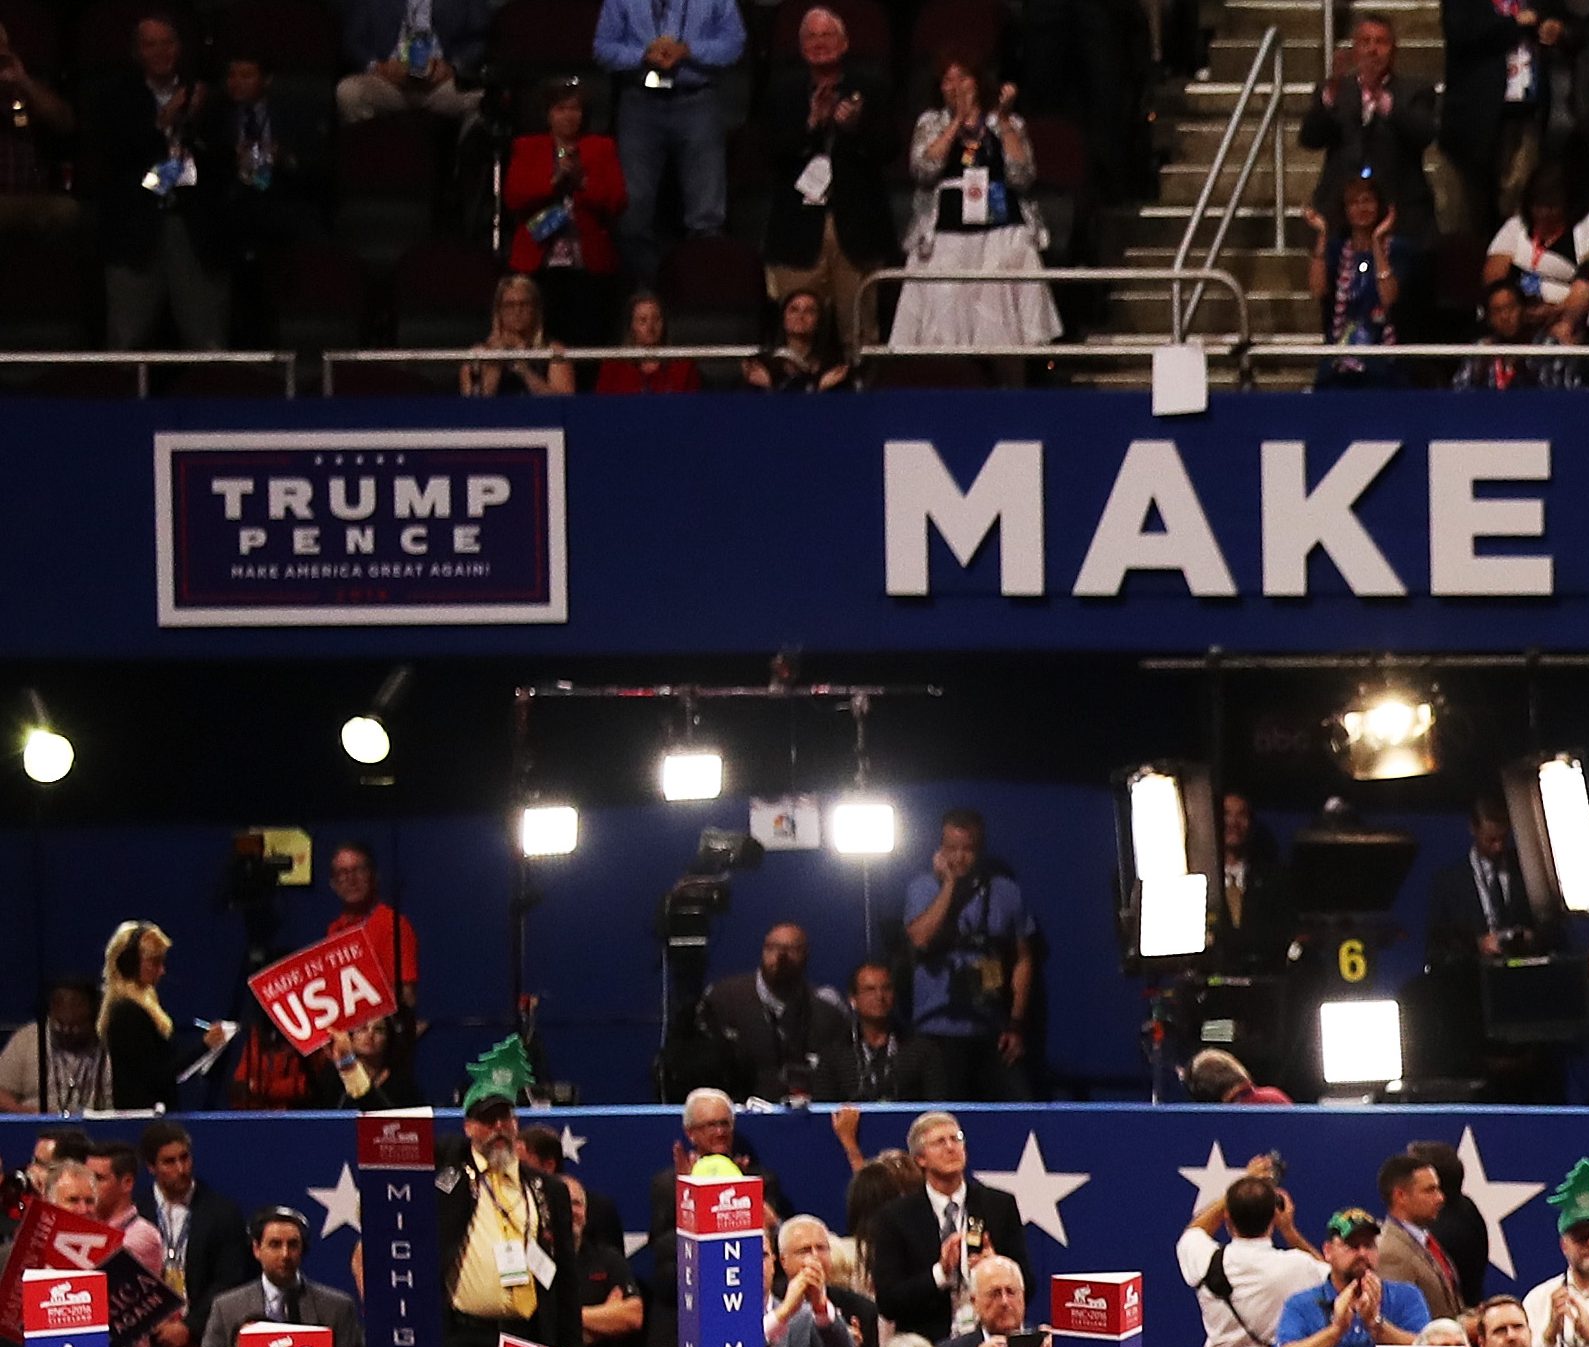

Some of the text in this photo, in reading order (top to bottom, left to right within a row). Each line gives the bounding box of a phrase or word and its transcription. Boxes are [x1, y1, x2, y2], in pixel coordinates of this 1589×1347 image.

[211, 474, 512, 520] TRUMP
[884, 439, 1553, 597] MAKE
[231, 559, 493, 580] MAKE AMERICA GREAT AGAIN!
[239, 525, 482, 556] PENCE
[262, 944, 364, 1002] MADE IN THE
[1338, 938, 1366, 983] 6
[272, 964, 383, 1041] USA
[684, 1242, 693, 1312] NEW
[723, 1240, 743, 1312] NEW
